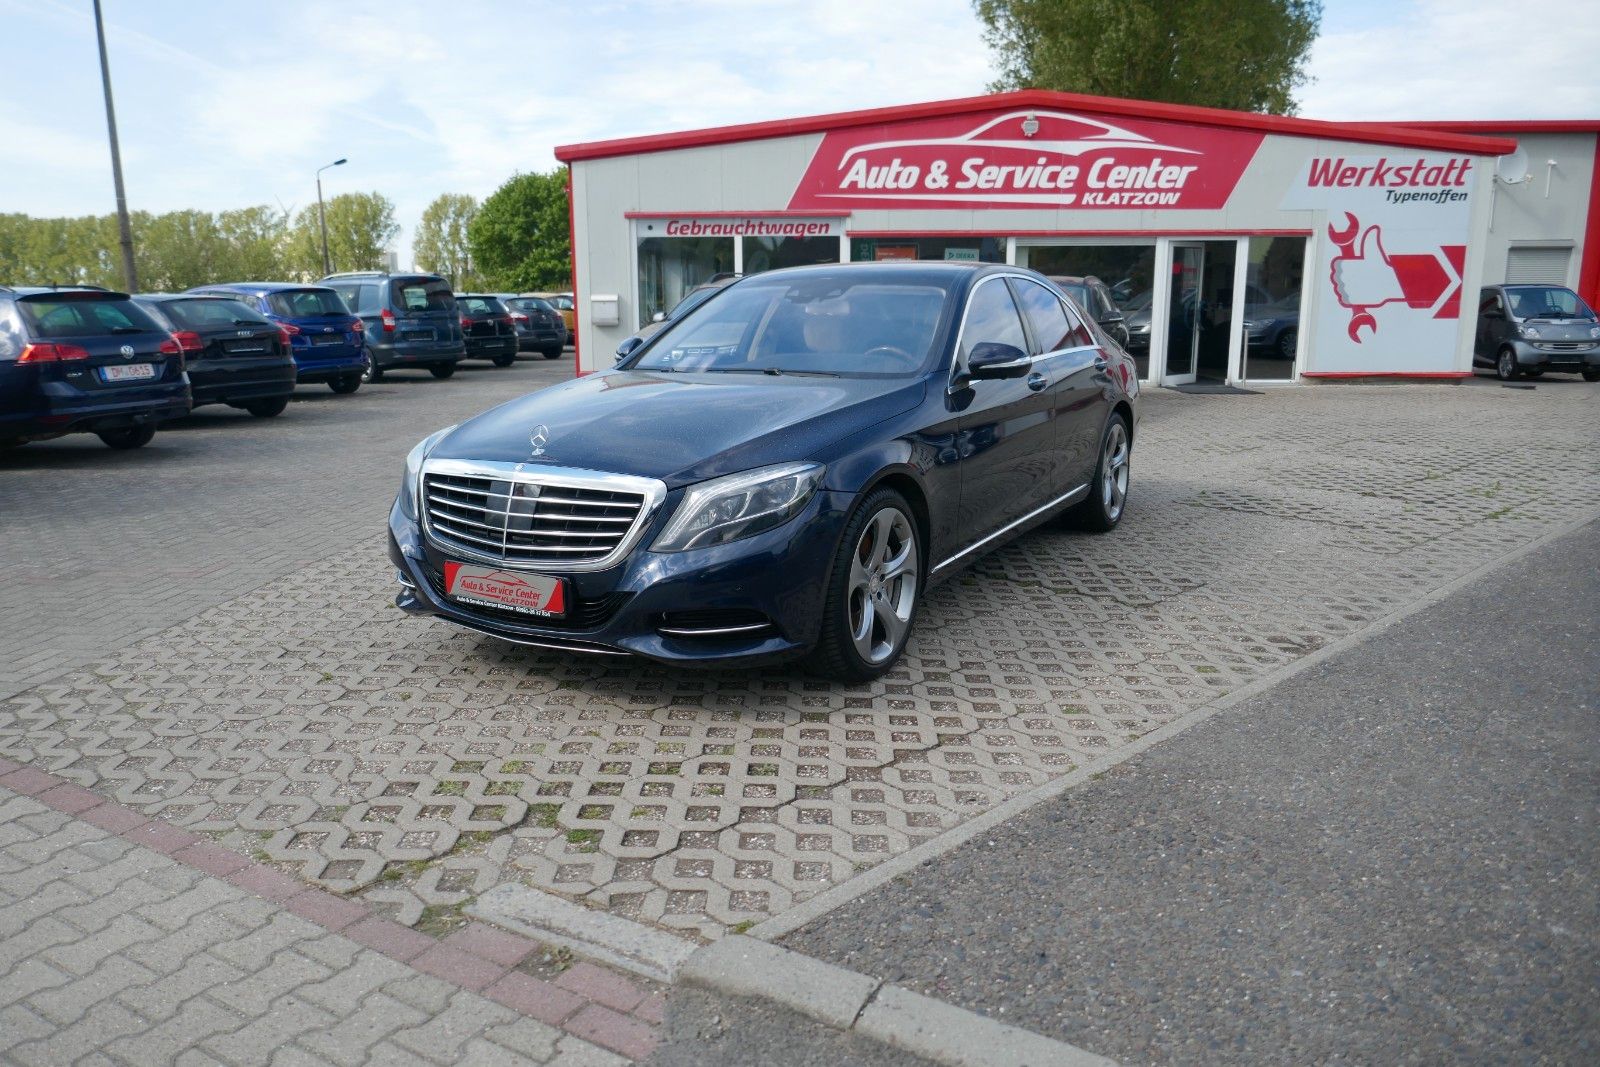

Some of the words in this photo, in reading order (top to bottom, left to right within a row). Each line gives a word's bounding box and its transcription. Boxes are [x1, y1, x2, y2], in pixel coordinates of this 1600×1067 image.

[839, 158, 920, 189] Auto
[924, 159, 949, 189] &
[955, 157, 1079, 189] Service
[1086, 157, 1198, 189] Center
[1307, 158, 1473, 187] Werkstatt
[1081, 192, 1181, 205] KLATZOW
[1386, 189, 1468, 204] Typenoffen
[666, 220, 830, 240] Gebrauchtwagen
[461, 580, 478, 592] Auto
[479, 584, 484, 592] &
[486, 584, 514, 597] Service
[515, 588, 542, 600] Center
[500, 596, 538, 607] KLATZOW
